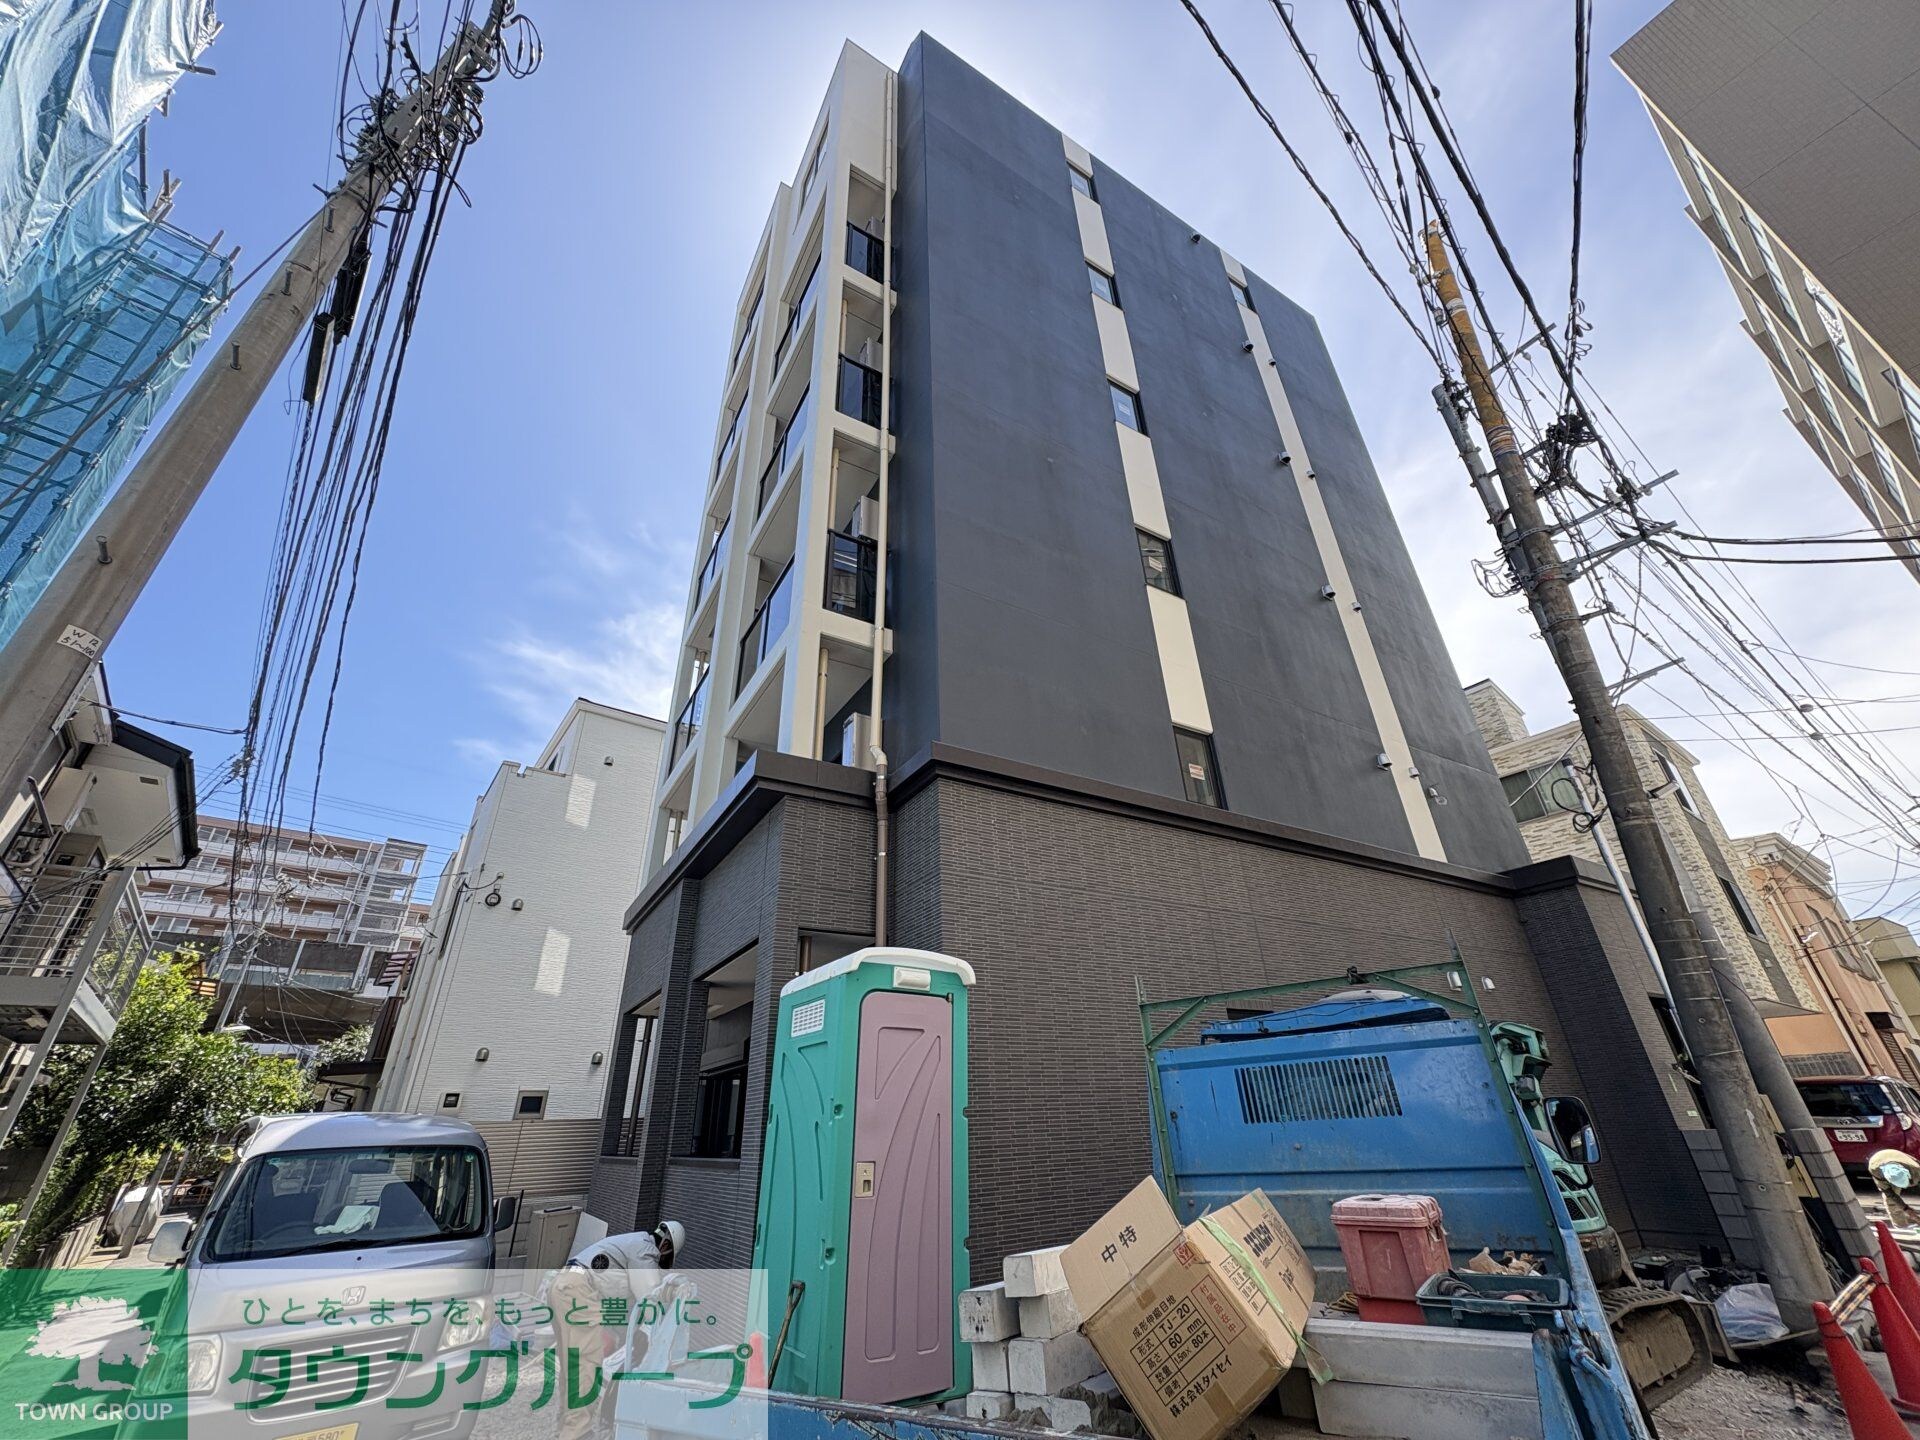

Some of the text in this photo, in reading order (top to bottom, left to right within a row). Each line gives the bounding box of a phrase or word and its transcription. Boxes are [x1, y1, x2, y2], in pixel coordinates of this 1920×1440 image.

[1168, 1318, 1202, 1349] 60 mm
[1137, 1338, 1155, 1357] 形式
[1146, 1352, 1162, 1371] 高さ
[1155, 1365, 1173, 1385] 数量
[1164, 1379, 1181, 1398] 備考
[1169, 1354, 1233, 1418] 株式会社タイセイ
